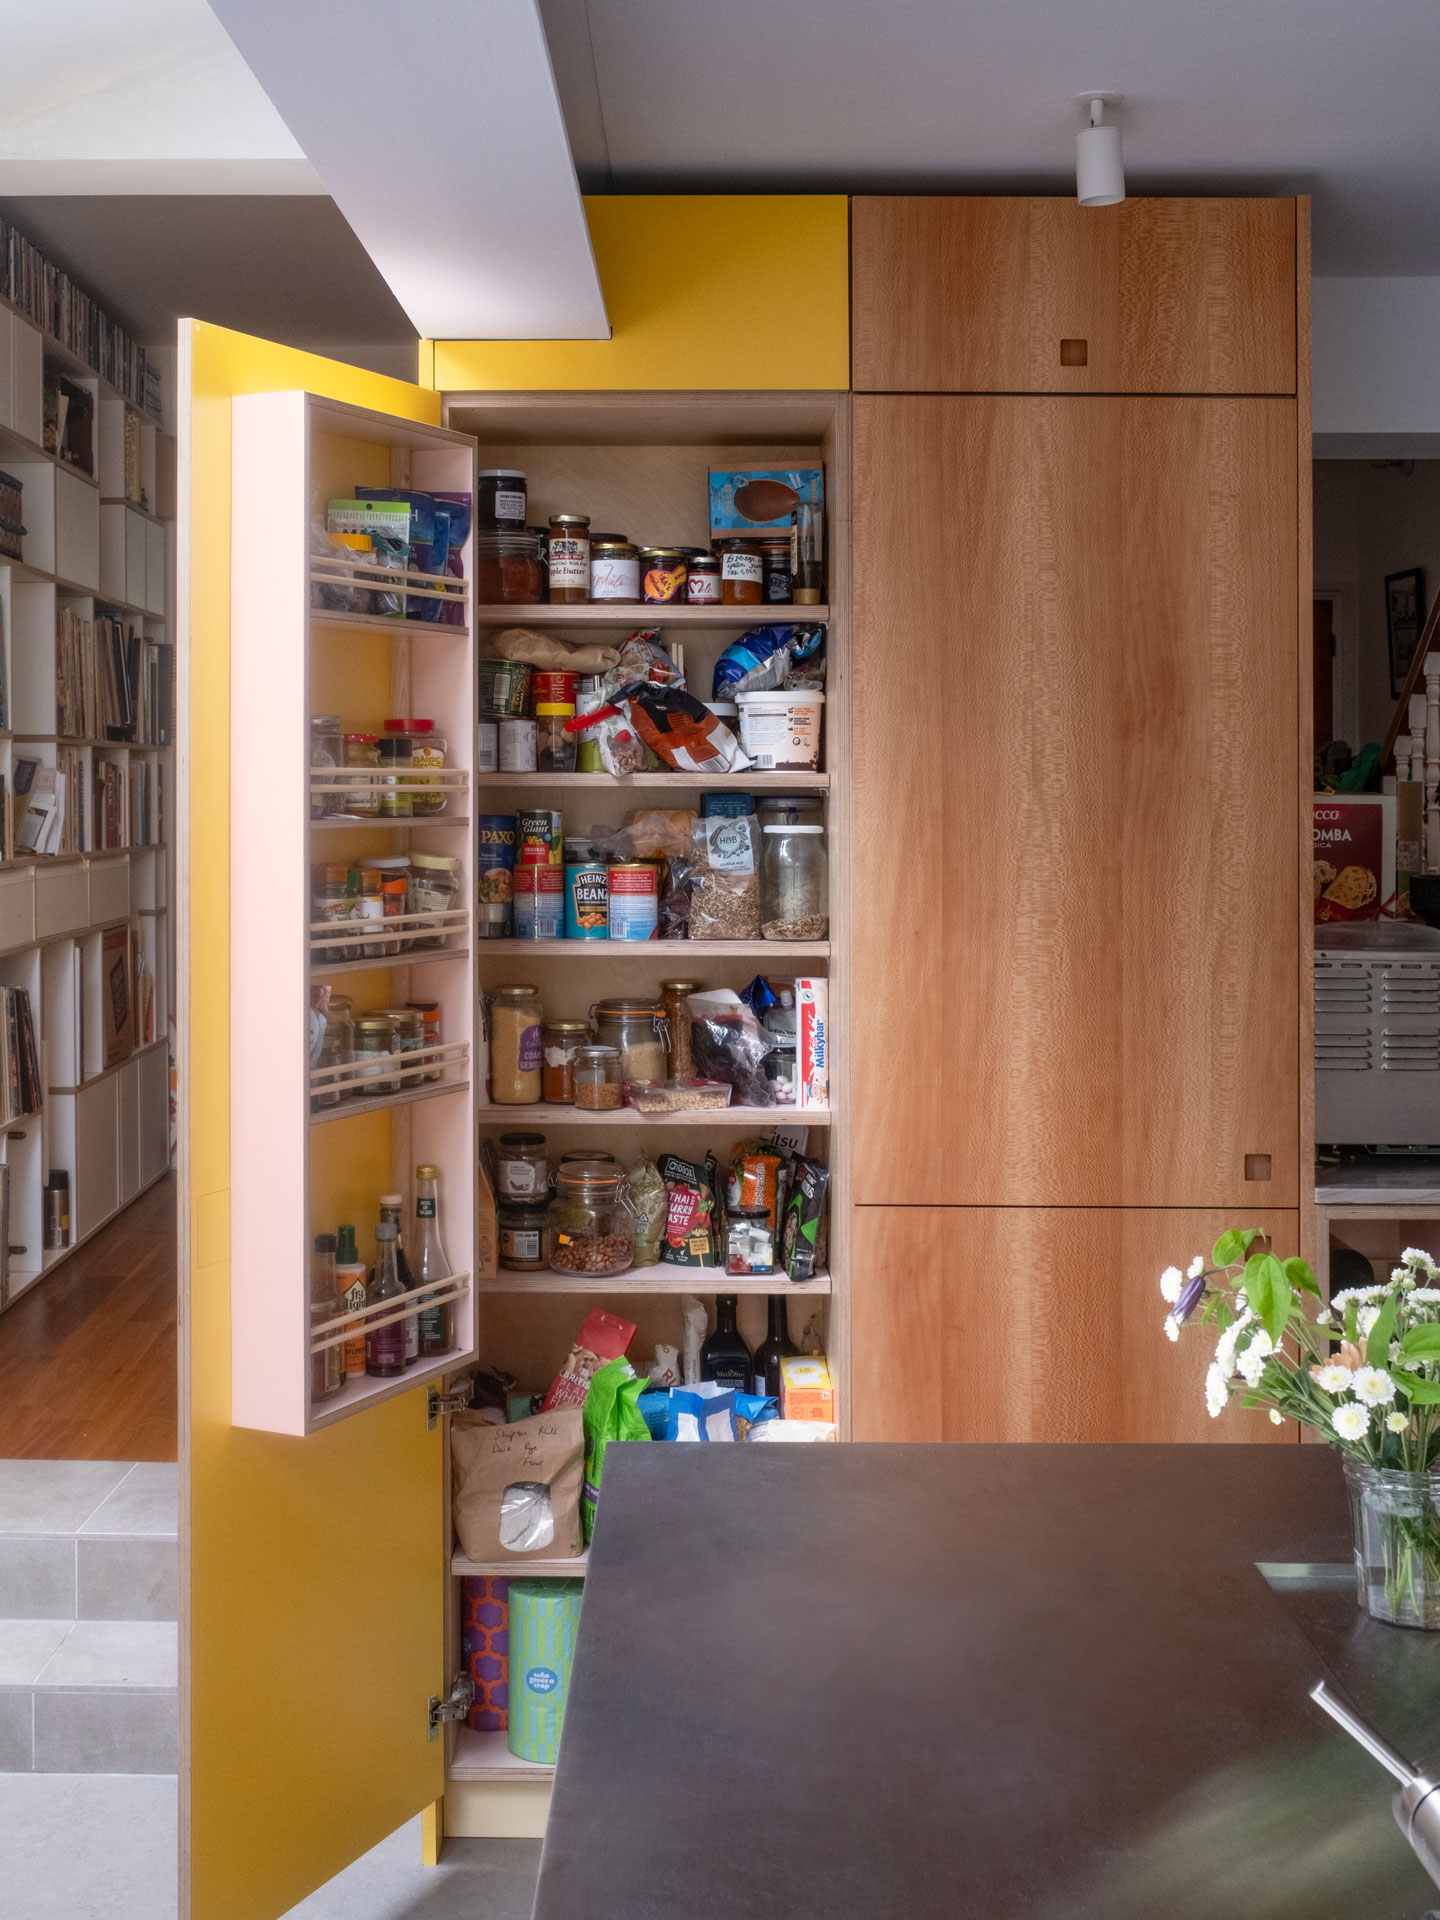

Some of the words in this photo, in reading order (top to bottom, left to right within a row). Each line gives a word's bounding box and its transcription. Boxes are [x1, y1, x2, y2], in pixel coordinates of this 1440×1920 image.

[551, 567, 562, 576] pple
[563, 566, 586, 575] Butter
[522, 818, 547, 826] Green
[523, 825, 549, 833] Giant
[480, 830, 515, 845] PAXO
[580, 874, 607, 885] HEINZ
[814, 1020, 826, 1068] Milkybar
[770, 1131, 799, 1149] itsu
[757, 1163, 765, 1190] Lentils
[669, 1191, 690, 1204] THAI
[669, 1203, 693, 1215] URRY
[668, 1213, 690, 1226] ASTE
[351, 1287, 364, 1301] fry
[563, 1370, 590, 1390] BRITIS
[558, 1379, 586, 1397] PLAI
[524, 1441, 538, 1455] Rye
